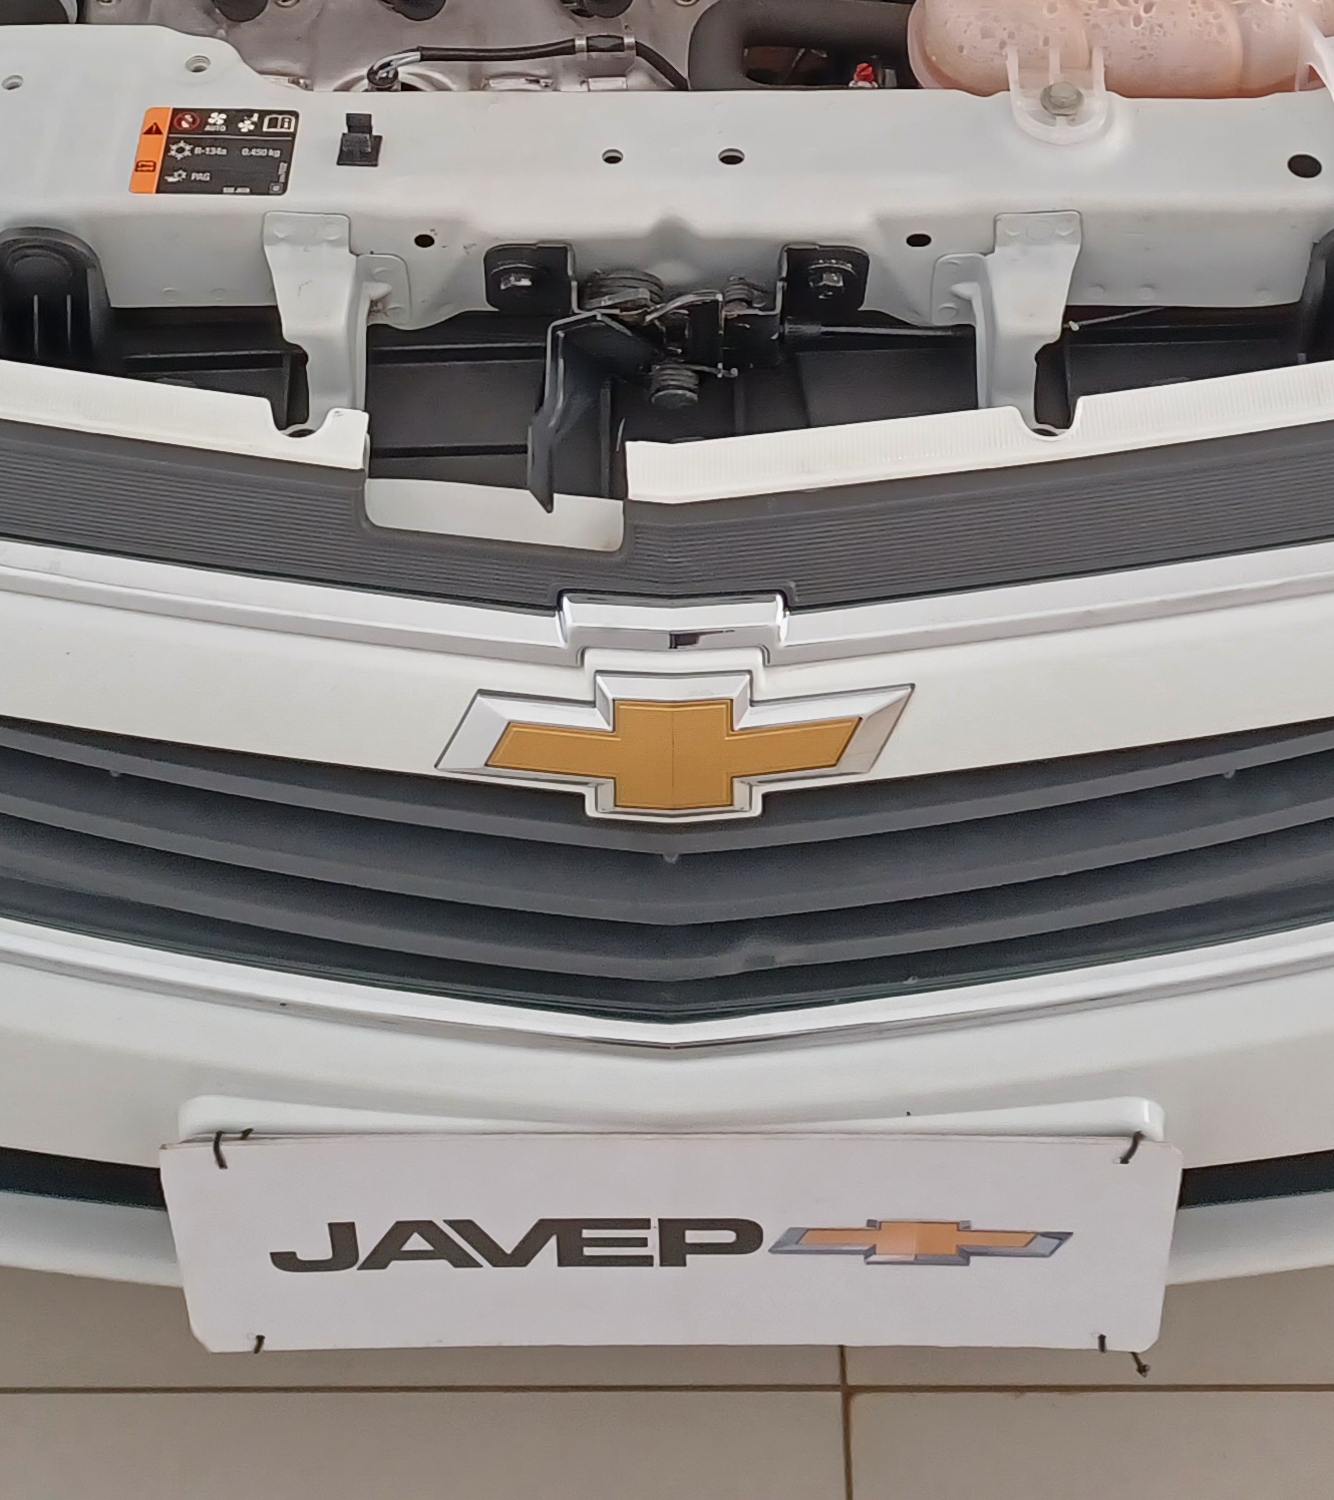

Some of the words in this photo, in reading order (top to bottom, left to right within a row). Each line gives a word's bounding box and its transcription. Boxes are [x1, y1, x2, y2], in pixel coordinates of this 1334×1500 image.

[204, 124, 227, 132] AUTO
[268, 148, 281, 159] kg
[191, 172, 211, 182] PAG
[270, 1218, 764, 1273] JAVEP
